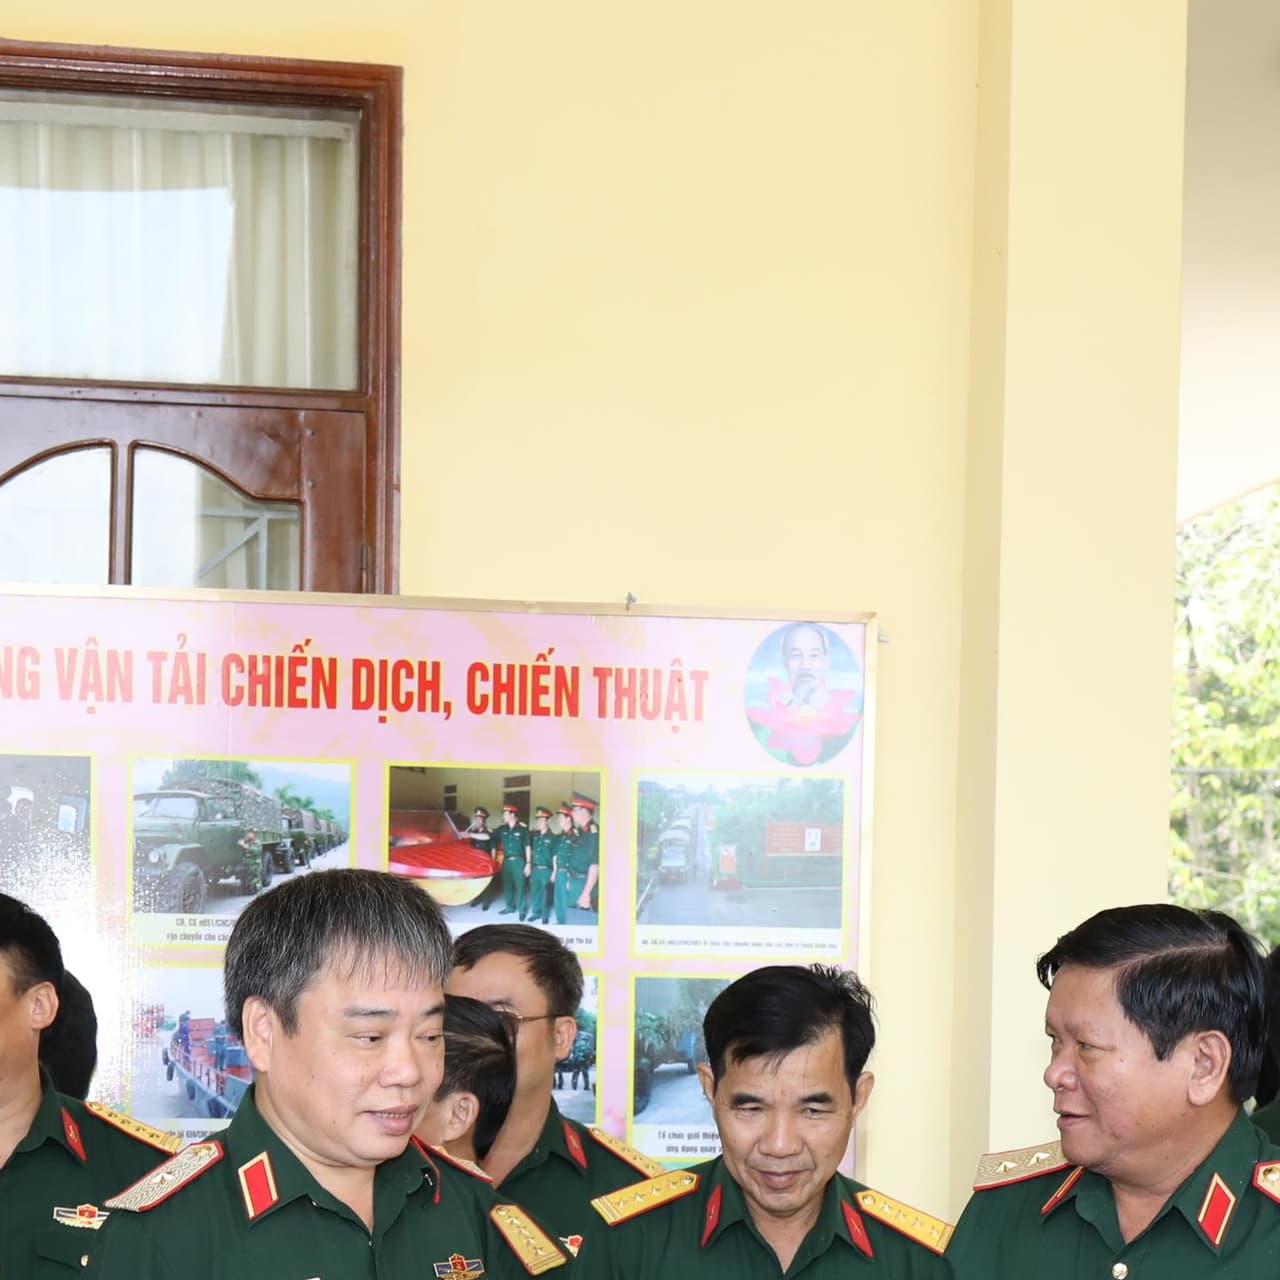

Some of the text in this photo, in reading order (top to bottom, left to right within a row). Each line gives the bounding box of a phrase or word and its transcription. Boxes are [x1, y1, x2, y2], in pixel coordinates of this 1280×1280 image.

[55, 636, 133, 715] VẬN
[146, 632, 208, 706] TẢI
[221, 638, 336, 711] CHIẾN
[351, 657, 452, 724] DỊCH,
[467, 646, 580, 718] CHIẾN
[592, 657, 710, 734] THUẬT
